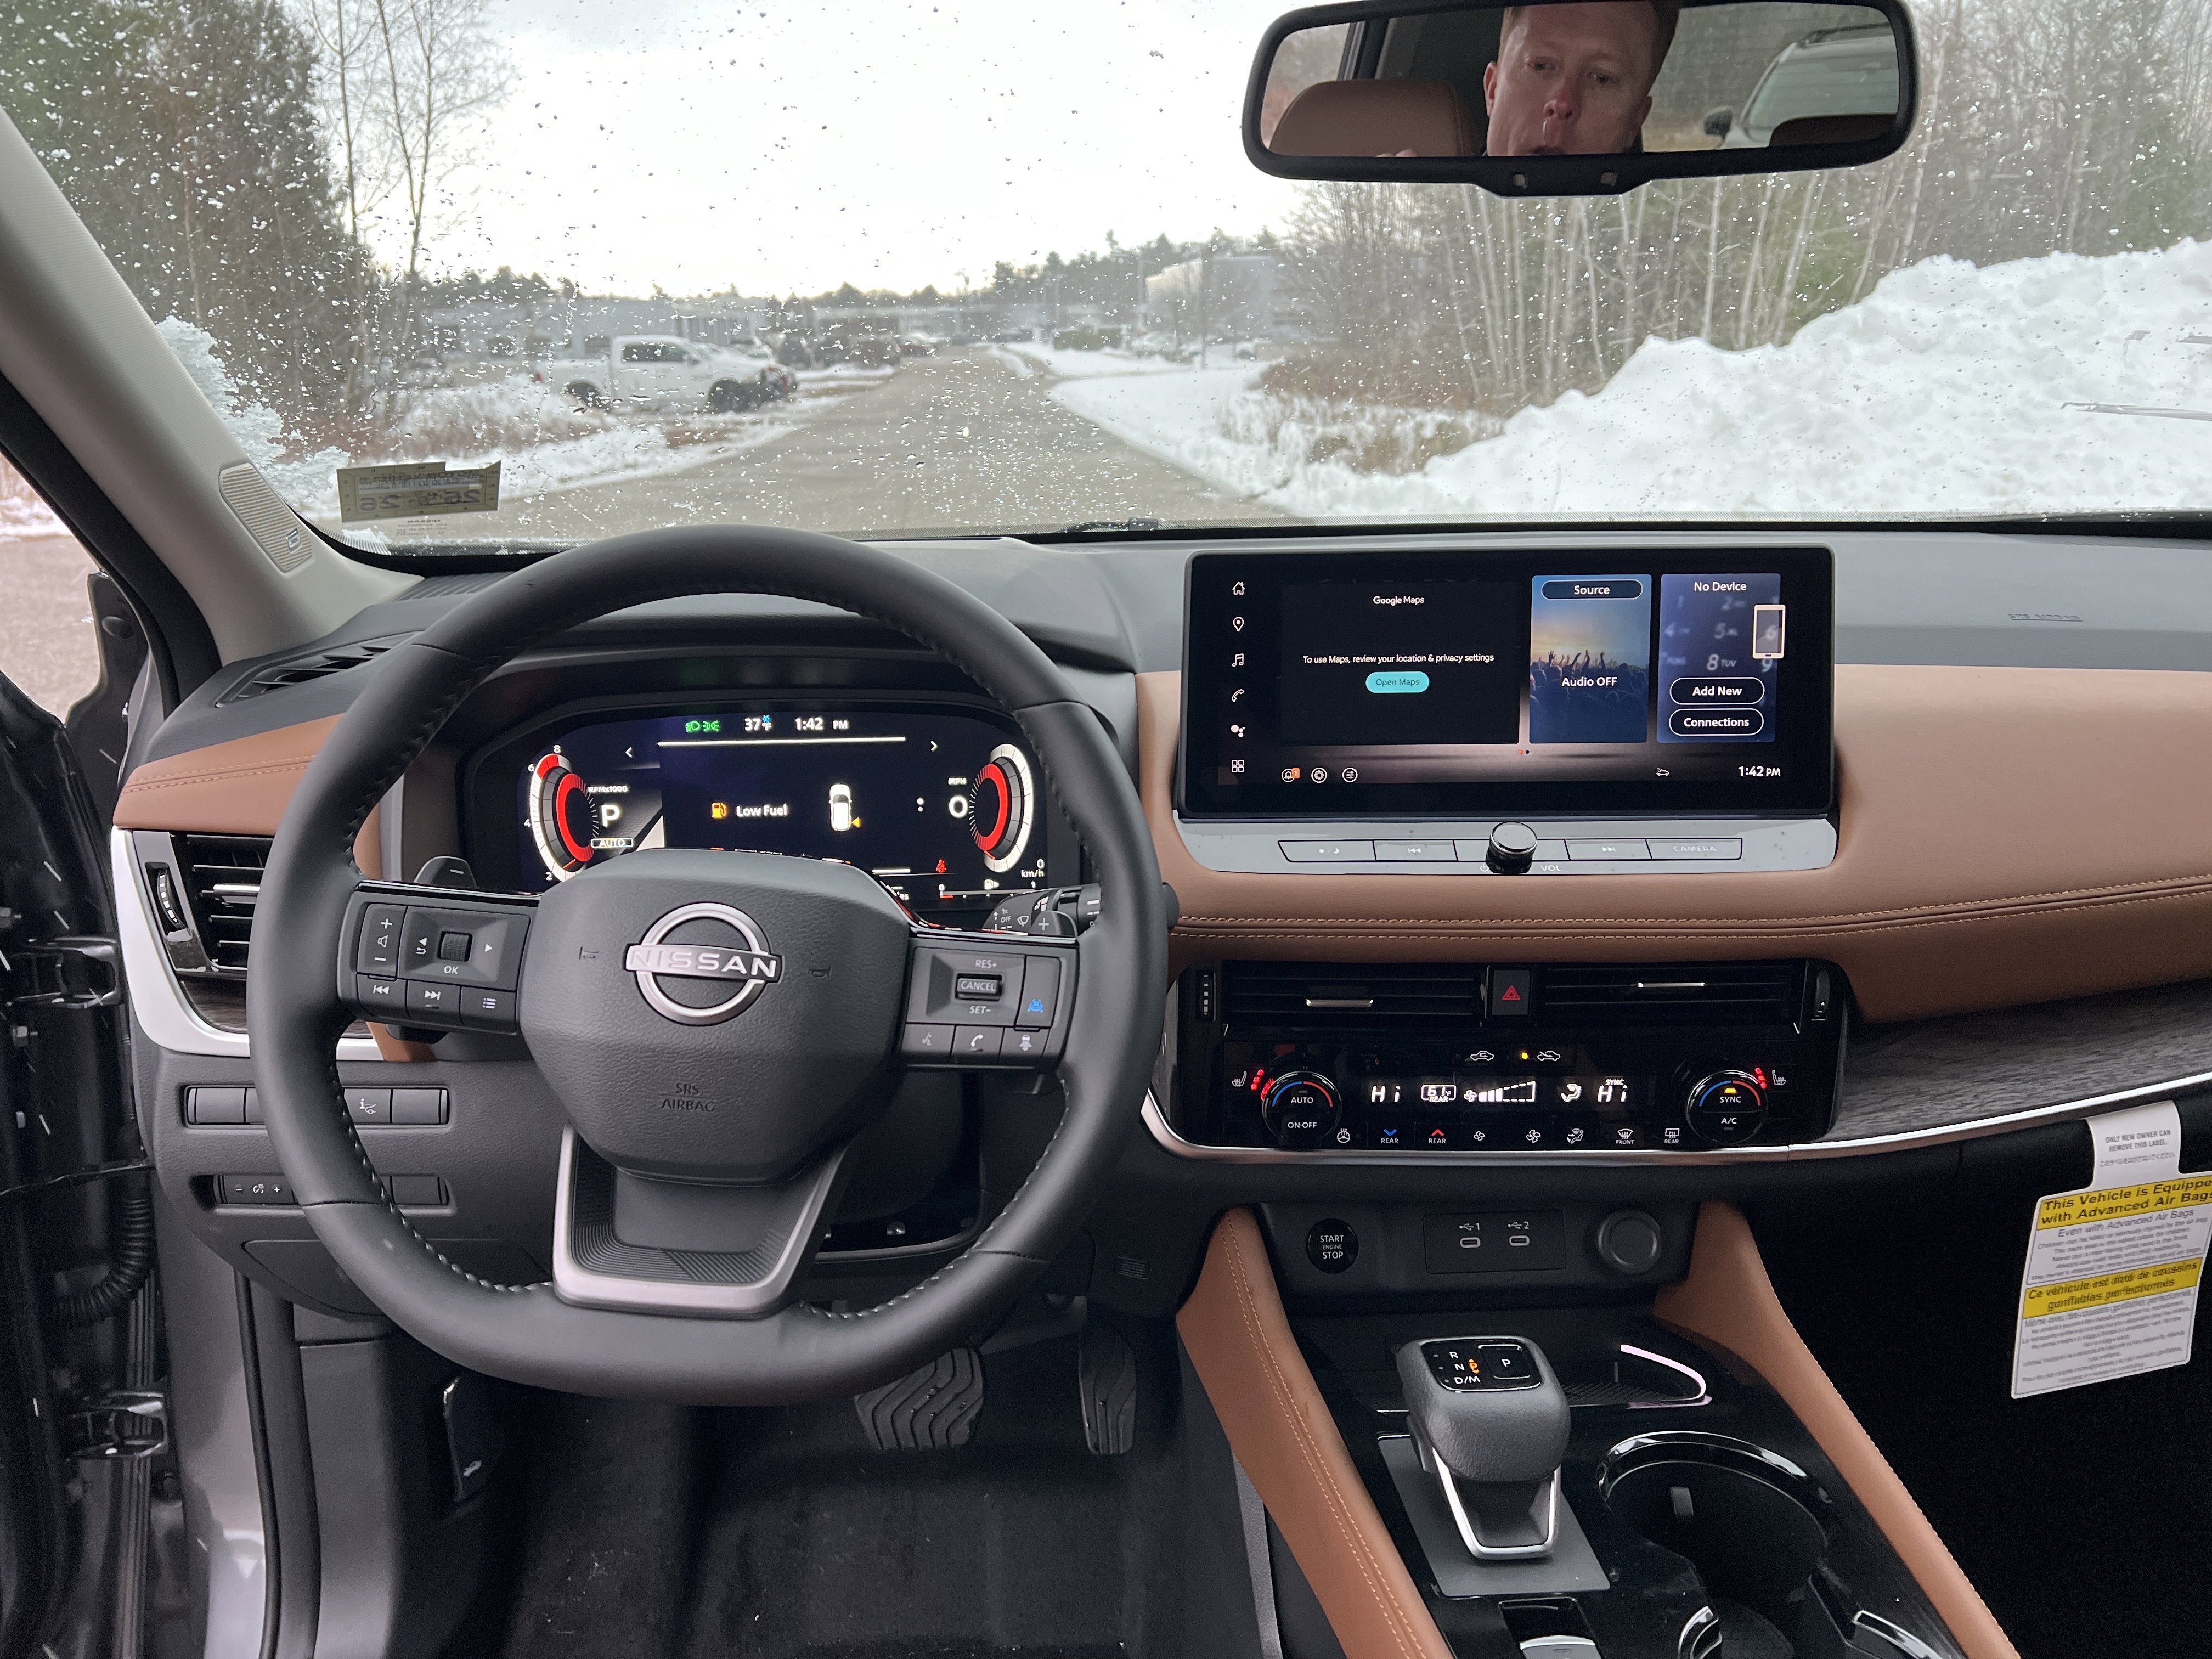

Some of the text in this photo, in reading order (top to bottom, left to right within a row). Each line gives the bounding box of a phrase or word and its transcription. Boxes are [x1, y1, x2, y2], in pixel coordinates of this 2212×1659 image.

[1573, 585, 1610, 595] Source
[1694, 582, 1747, 591] No Device
[1373, 596, 1425, 606] Google Maps
[1328, 655, 1351, 664] Maps,
[1352, 655, 1377, 663] review
[1378, 656, 1395, 664] your
[1396, 654, 1426, 663] location
[1435, 654, 1463, 664] privacy
[1464, 653, 1494, 663] settings
[1375, 678, 1420, 687] Open Maps
[1562, 676, 1617, 686] Audio OFF
[1692, 686, 1742, 696] Add New
[795, 717, 823, 731] 1:42
[832, 720, 849, 730] PM
[1683, 717, 1750, 727] Connections
[554, 745, 561, 753] 8
[528, 764, 535, 772] 6
[1738, 766, 1781, 777] 1:42 PM
[601, 804, 620, 827] P
[736, 804, 788, 817] Low Fuel
[1021, 869, 1045, 878] km/h
[630, 949, 777, 978] NISSAN
[975, 959, 997, 969] RES+
[444, 966, 459, 975] OK
[961, 980, 996, 991] CANCEL
[676, 1083, 699, 1095] SRS
[662, 1098, 715, 1112] AIRBAG
[2105, 1135, 2120, 1143] ONLY
[2136, 1131, 2158, 1139] OWNER
[2109, 1143, 2133, 1152] REMOVE
[2044, 1199, 2074, 1211] This
[2079, 1189, 2132, 1205] Vehicle
[2136, 1186, 2148, 1197] is
[2041, 1211, 2072, 1224] with
[2076, 1199, 2150, 1220] Advanced
[2154, 1195, 2176, 1206] Air
[2058, 1209, 2194, 1238] Even with Advanced Air Bags
[1320, 1234, 1344, 1243] START
[1323, 1251, 1344, 1259] STOP
[2028, 1289, 2043, 1300] Ce
[1469, 1362, 1478, 1370] P
[1454, 1376, 1481, 1384] D/M
